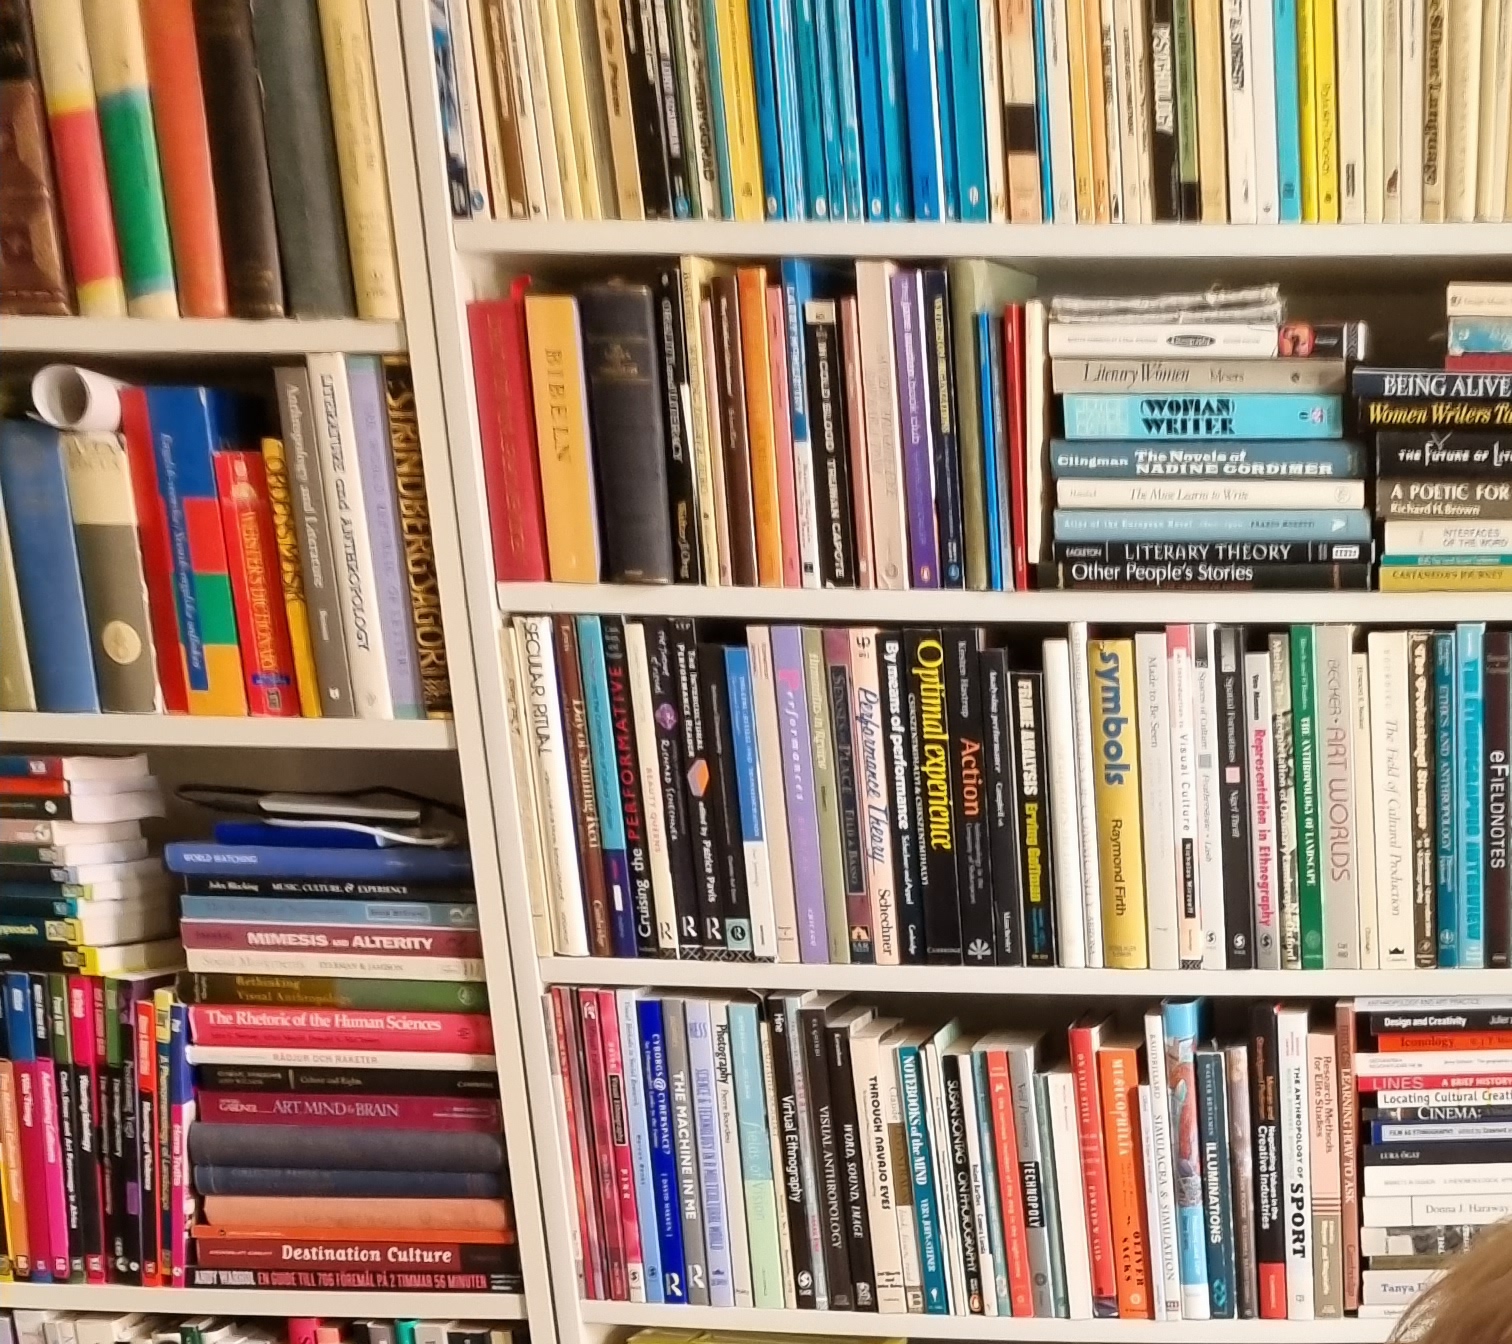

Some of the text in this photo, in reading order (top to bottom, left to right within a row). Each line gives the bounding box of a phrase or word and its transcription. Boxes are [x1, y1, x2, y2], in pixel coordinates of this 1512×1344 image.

[545, 349, 571, 462] BIBELN
[1140, 399, 1236, 416] (WOMAN)
[1369, 404, 1427, 424] Women
[1431, 403, 1491, 424] Writers
[1383, 376, 1511, 397] BEING ALIVE
[1058, 455, 1129, 467] Clingman
[1135, 449, 1246, 462] The Novels of
[1142, 418, 1234, 435] WRITER
[1135, 463, 1333, 475] NADINE GORDIMER
[1391, 484, 1402, 500] A
[1410, 484, 1468, 501] POETIC
[1477, 484, 1509, 501] FOR
[1072, 563, 1253, 585] Other People's Stories
[1125, 543, 1292, 560] LITERARY THEORY
[523, 623, 552, 757] SECULAR RITUAL
[1095, 652, 1131, 786] symbols
[883, 641, 910, 829] By means of performance
[912, 640, 953, 850] Optimal experience
[1327, 727, 1347, 772] ART
[609, 667, 652, 937] Cruising the PERFORMATIVE
[857, 688, 888, 864] Performance Theory
[960, 738, 982, 816] Action
[1178, 734, 1193, 831] Visual Culture
[1250, 729, 1273, 927] Representation in Ethnography
[1329, 778, 1350, 881] WORLDS
[1110, 819, 1127, 916] Raymond Firth
[248, 932, 328, 947] MIMESIS
[352, 935, 433, 950] ALTERITY
[877, 888, 894, 955] Schechner
[206, 1010, 442, 1030] The Rhetoric of the Human Sciences
[715, 1024, 731, 1084] Photography
[775, 1014, 785, 1032] Hine
[1372, 1076, 1423, 1090] LINES
[1383, 1094, 1425, 1105] Locating
[1429, 1092, 1471, 1103] Cultural
[672, 1071, 696, 1220] THE MACHINE IN ME
[782, 1095, 802, 1203] Virtual Ethnography
[903, 1055, 927, 1186] NOTEBOOKS of the MIND
[1341, 1068, 1354, 1203] LEARNING HOW TO ASK
[819, 1106, 841, 1249] VISUAL ANTHROPOLOGY
[946, 1080, 978, 1272] SUSAN SONTAG ON PHOTOGRAPHY
[1023, 1162, 1041, 1228] TECHNOPOLY
[1205, 1142, 1221, 1243] ILLUMINATIONS
[1289, 1067, 1305, 1259] THE ANTHROPOLOGY OF SPORT
[282, 1245, 452, 1264] Destination Culture
